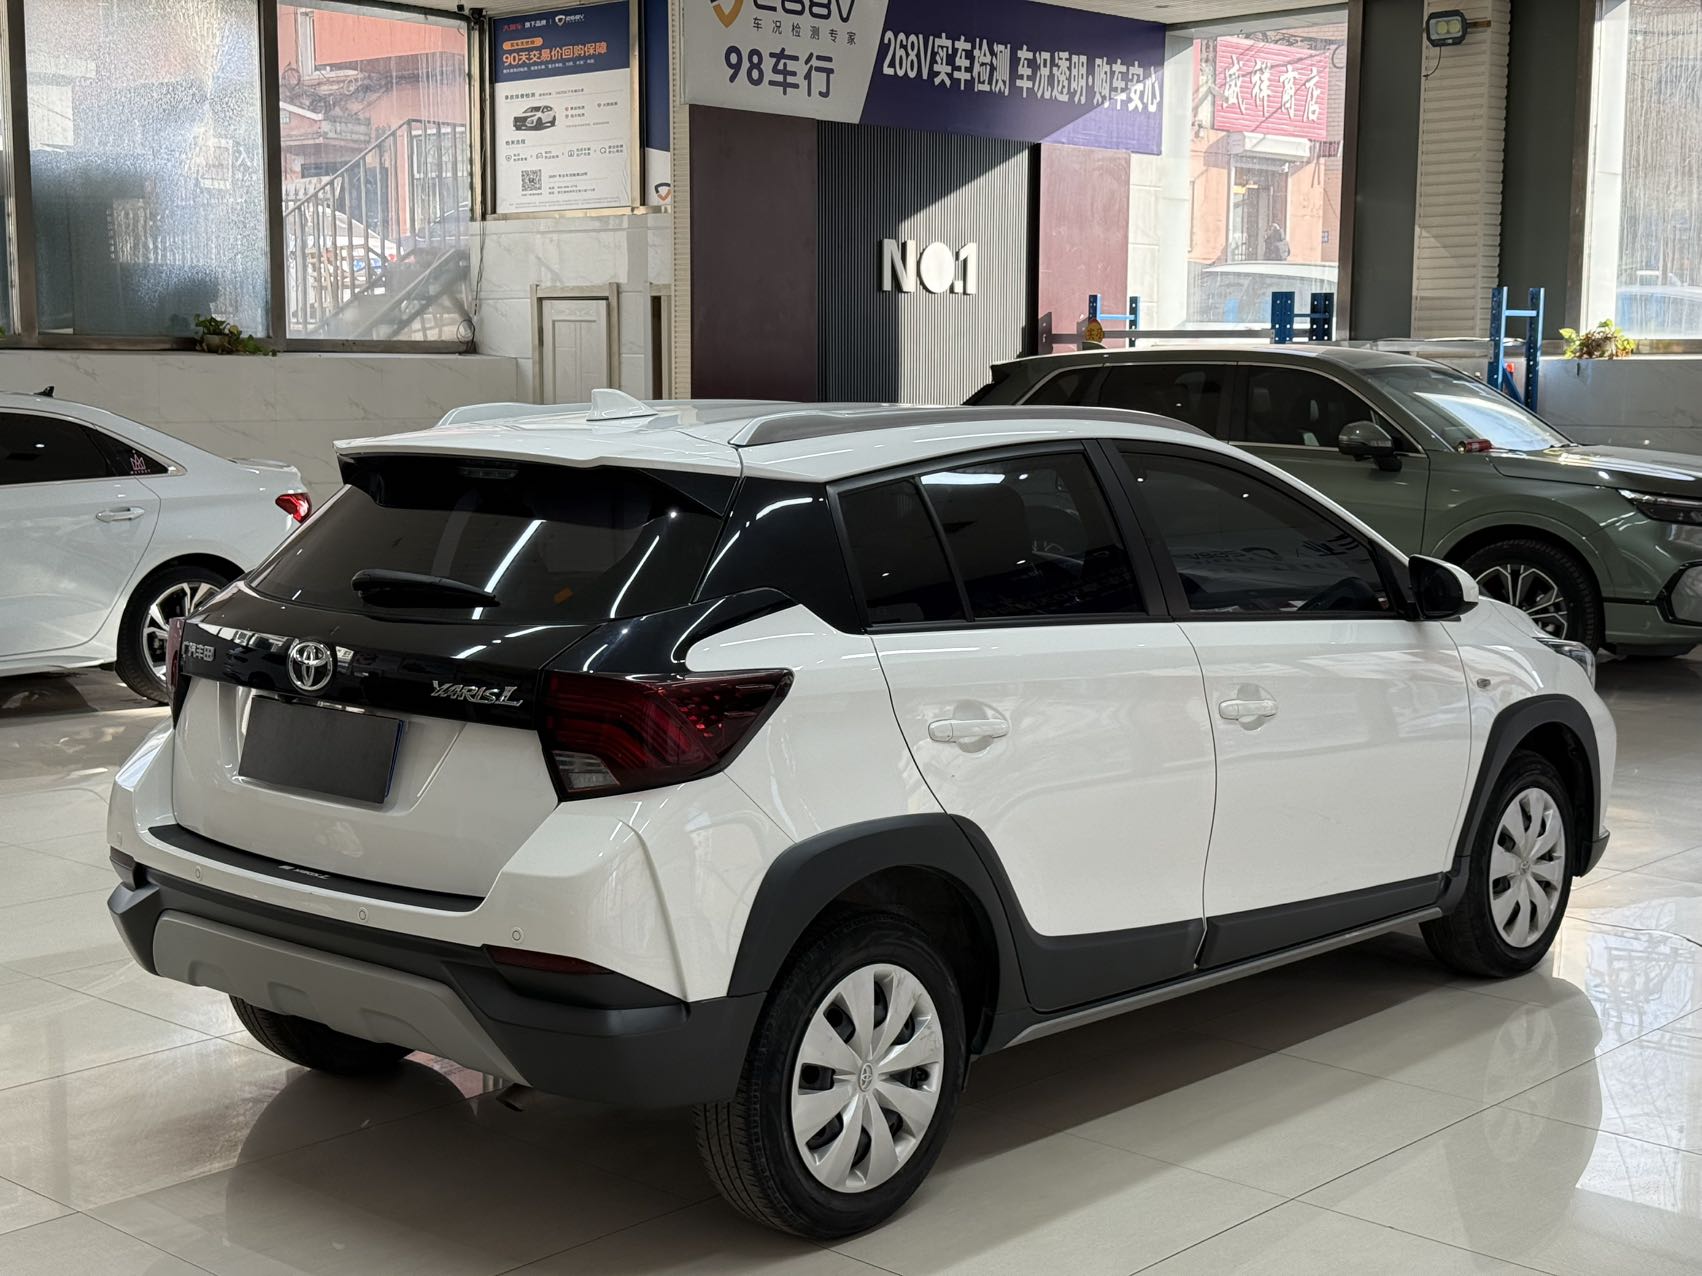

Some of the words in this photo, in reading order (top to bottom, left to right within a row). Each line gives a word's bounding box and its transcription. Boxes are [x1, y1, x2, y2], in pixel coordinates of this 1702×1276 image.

[752, 17, 857, 46] 车况检测专家
[502, 41, 608, 66] 90天交易价回购保障
[724, 45, 835, 99] 98车行
[882, 30, 1011, 97] 268V实车检测
[1015, 45, 1160, 113] 车况透明·购车安心
